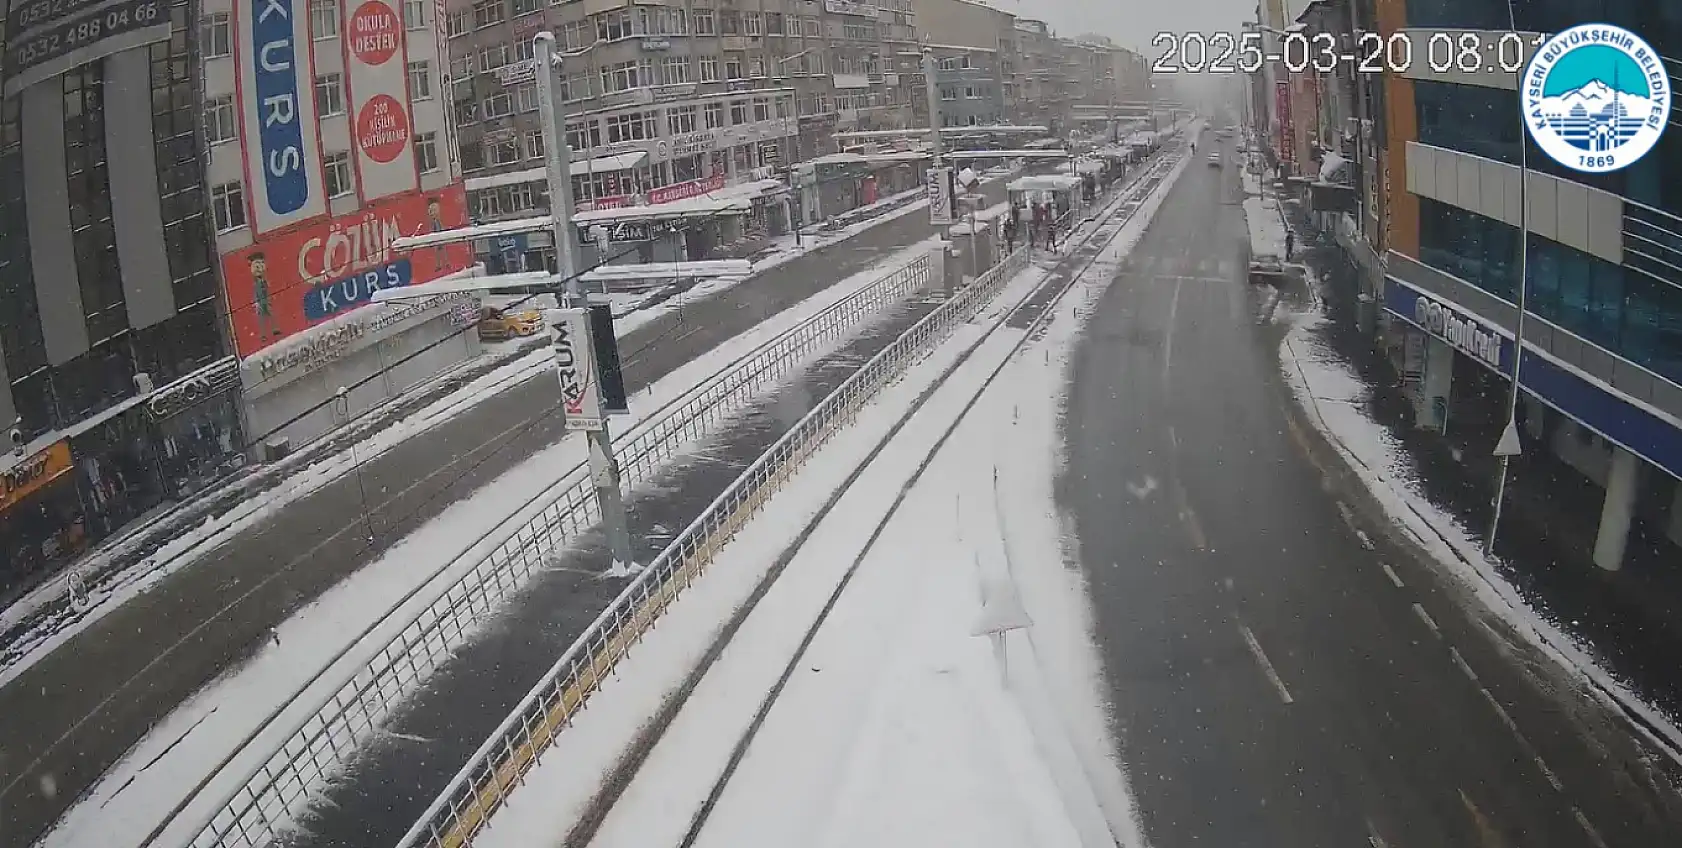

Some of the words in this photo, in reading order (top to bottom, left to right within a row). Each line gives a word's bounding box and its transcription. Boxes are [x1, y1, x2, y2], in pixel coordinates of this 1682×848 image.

[18, 34, 60, 65] 0532
[65, 19, 101, 45] 488
[106, 9, 130, 30] 04
[135, 2, 157, 22] 66
[355, 33, 396, 53] DESTEK
[356, 14, 392, 32] OKULA
[259, 0, 299, 177] KURS
[298, 213, 401, 285] ÇÖZÜM
[320, 264, 400, 312] KURS
[551, 319, 584, 414] KARUM
